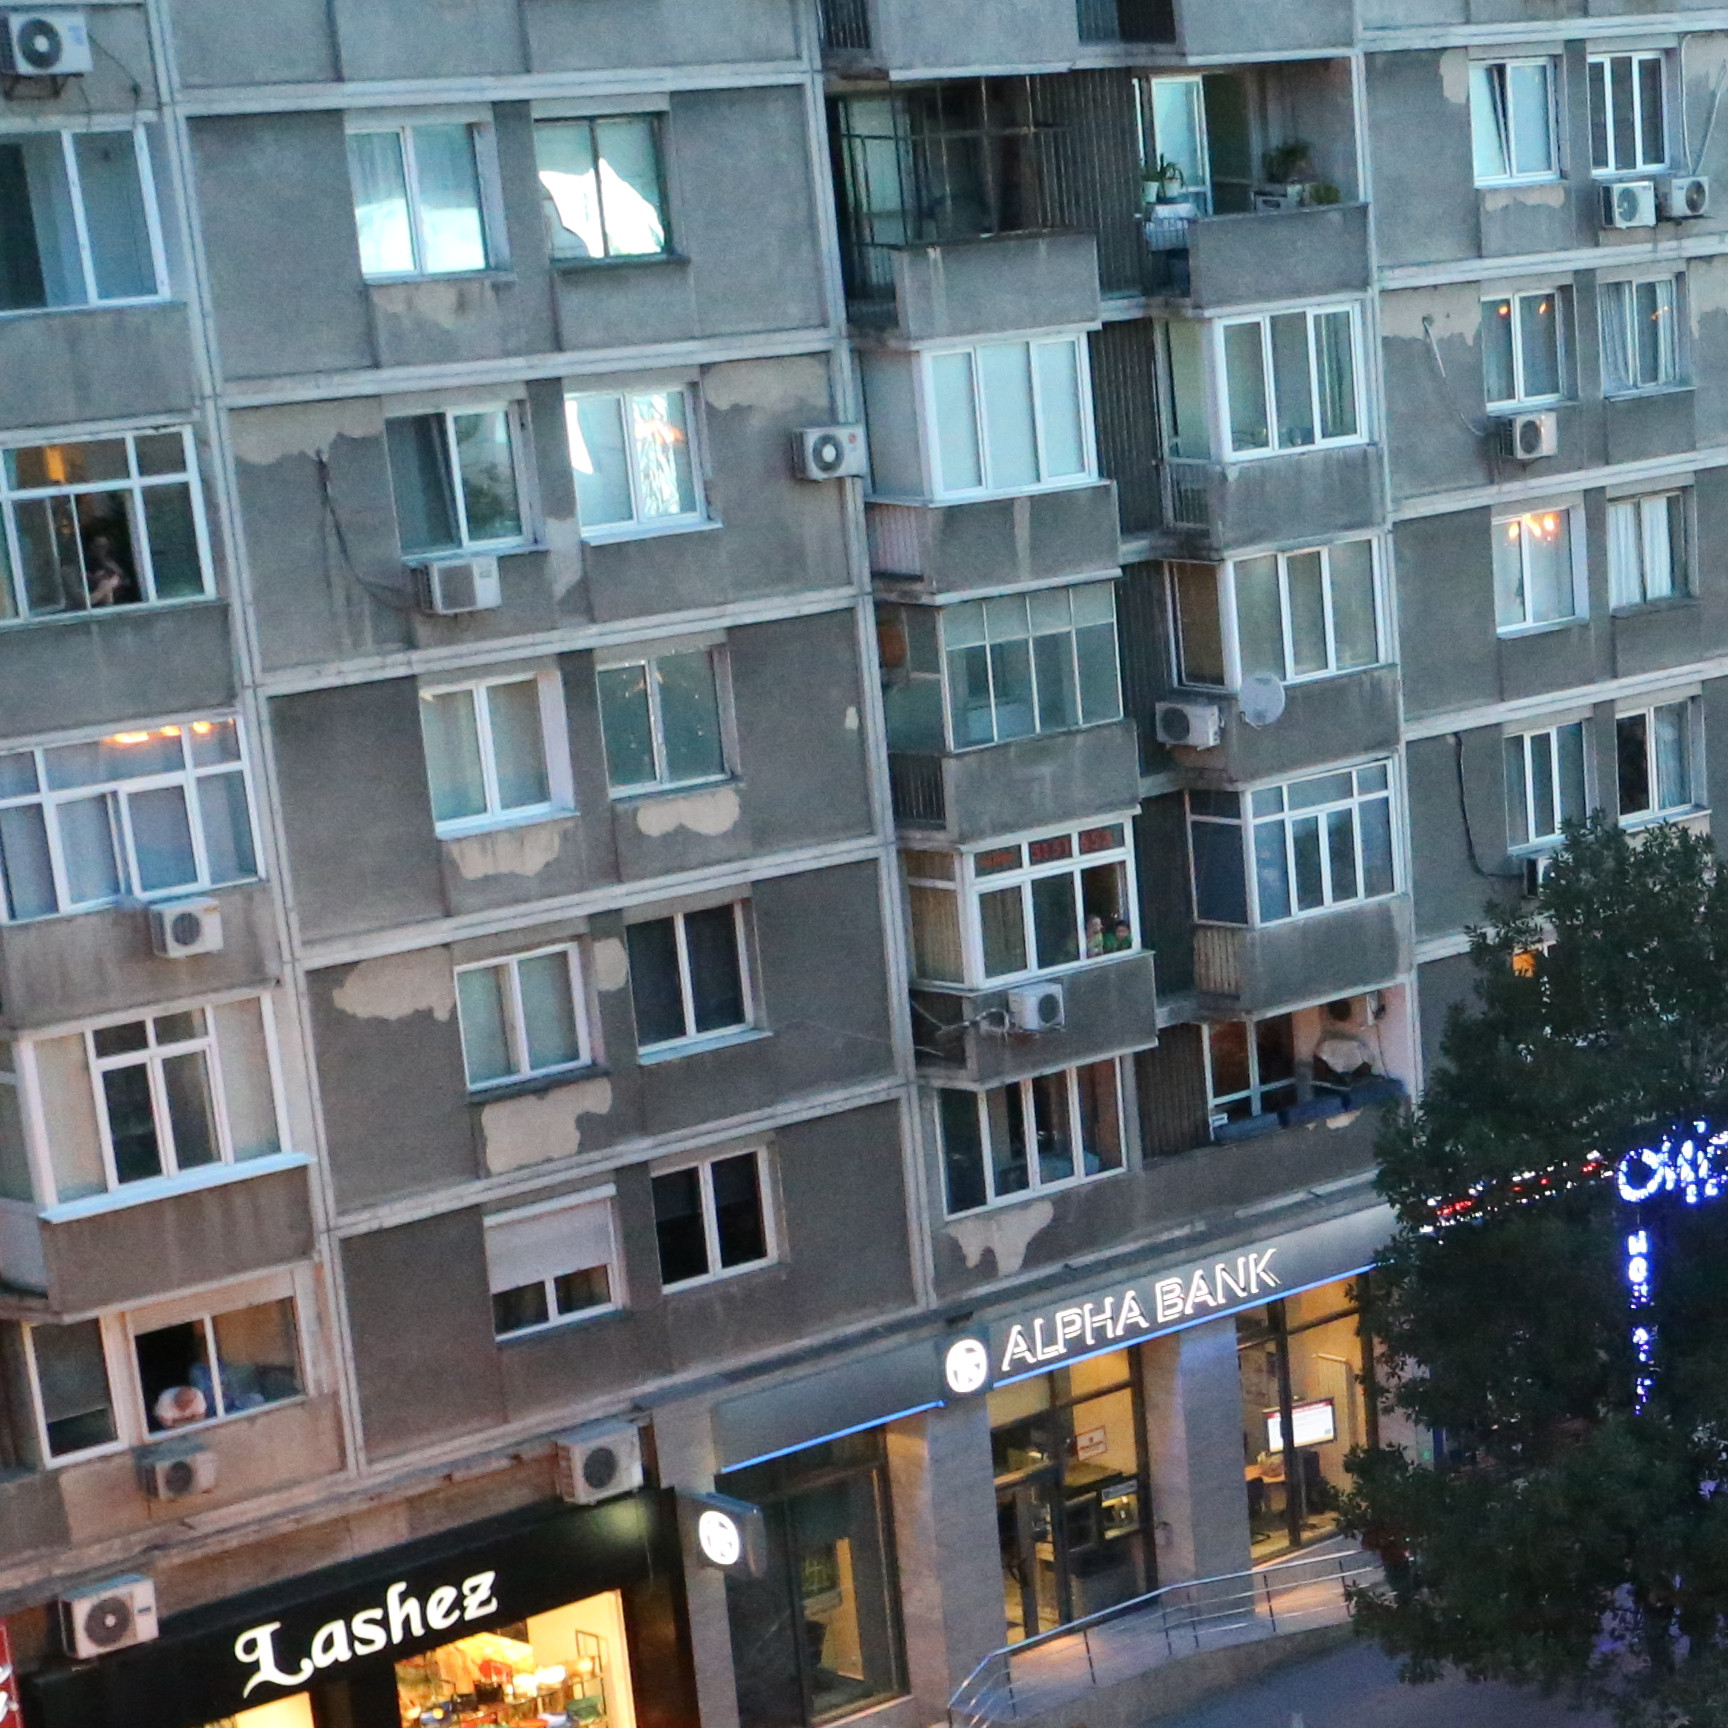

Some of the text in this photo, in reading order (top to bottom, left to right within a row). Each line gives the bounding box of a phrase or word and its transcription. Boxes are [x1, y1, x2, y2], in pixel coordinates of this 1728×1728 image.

[1001, 1249, 1282, 1371] ALPHA BANK
[234, 1570, 498, 1699] Lashez
